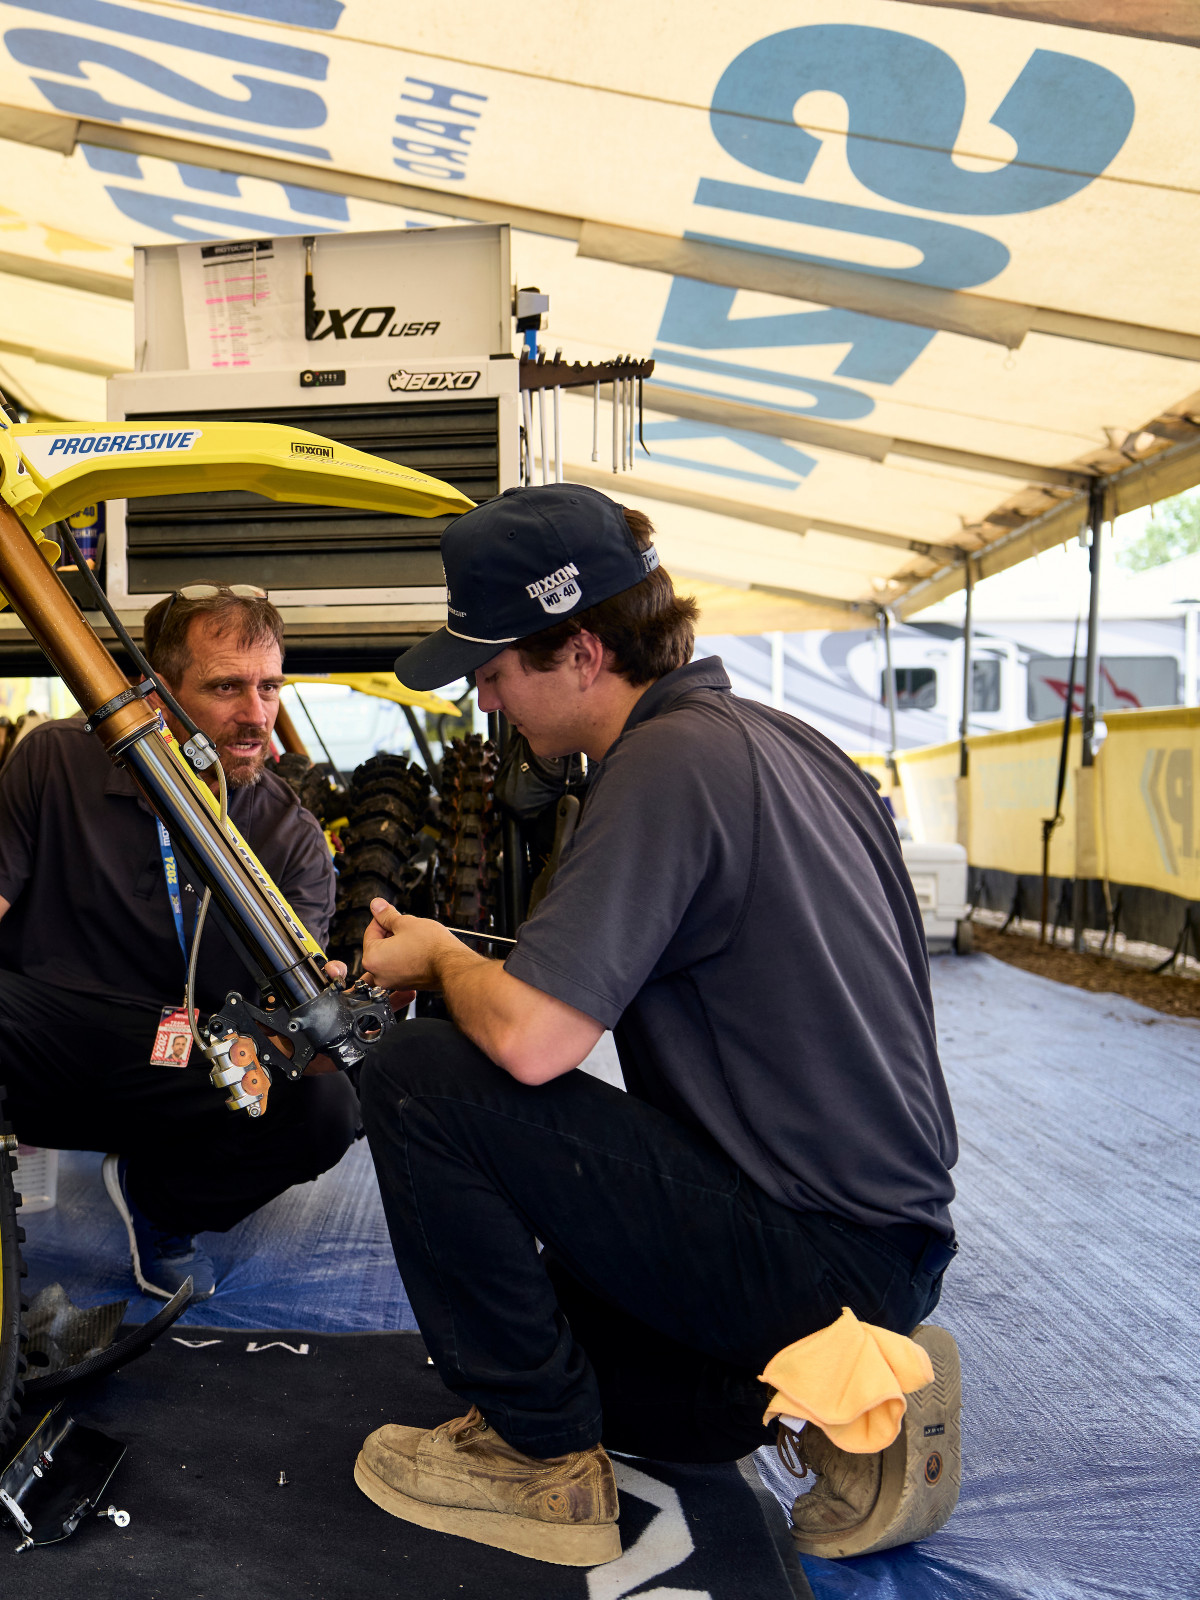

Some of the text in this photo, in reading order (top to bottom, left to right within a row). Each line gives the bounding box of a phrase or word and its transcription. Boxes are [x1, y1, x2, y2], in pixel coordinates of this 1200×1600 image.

[387, 321, 441, 338] USA
[406, 371, 481, 391] BOXO
[48, 431, 195, 456] PROGRESSIVE
[294, 444, 331, 458] DIXXON
[525, 562, 580, 599] DIXXON
[164, 856, 178, 885] 2024
